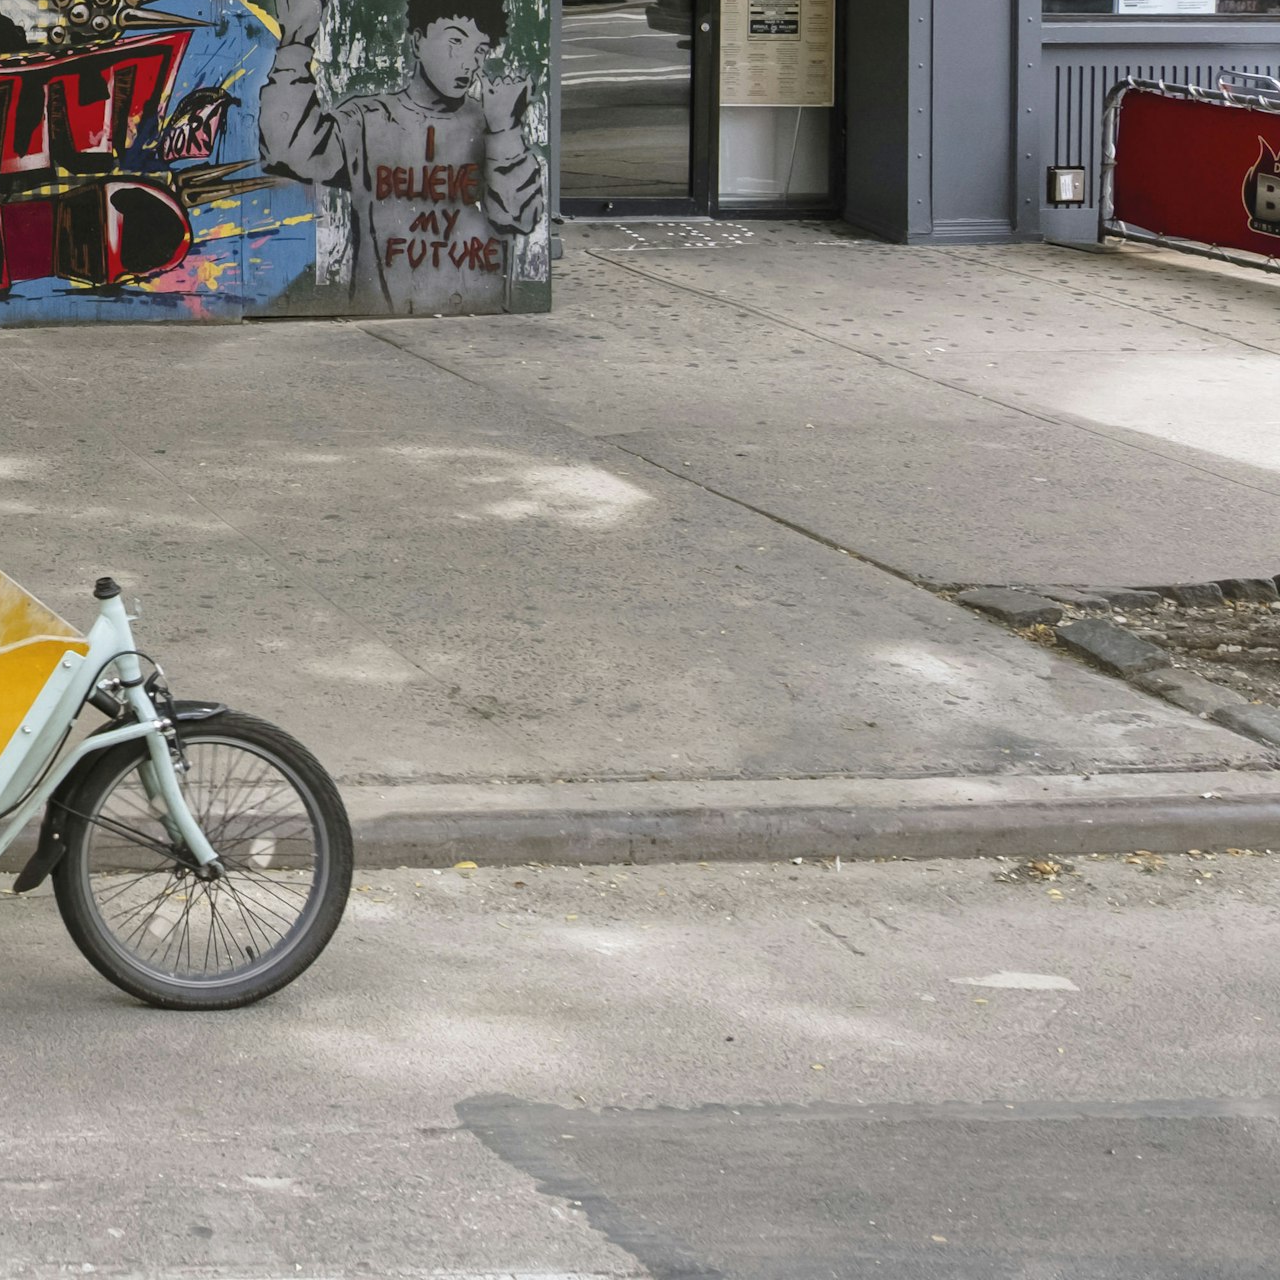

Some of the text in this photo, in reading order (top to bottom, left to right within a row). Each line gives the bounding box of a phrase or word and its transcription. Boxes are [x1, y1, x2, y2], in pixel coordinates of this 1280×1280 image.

[425, 125, 436, 162] I
[376, 162, 480, 206] BELIEVE
[408, 208, 461, 242] MY
[385, 236, 501, 271] FUTURE
